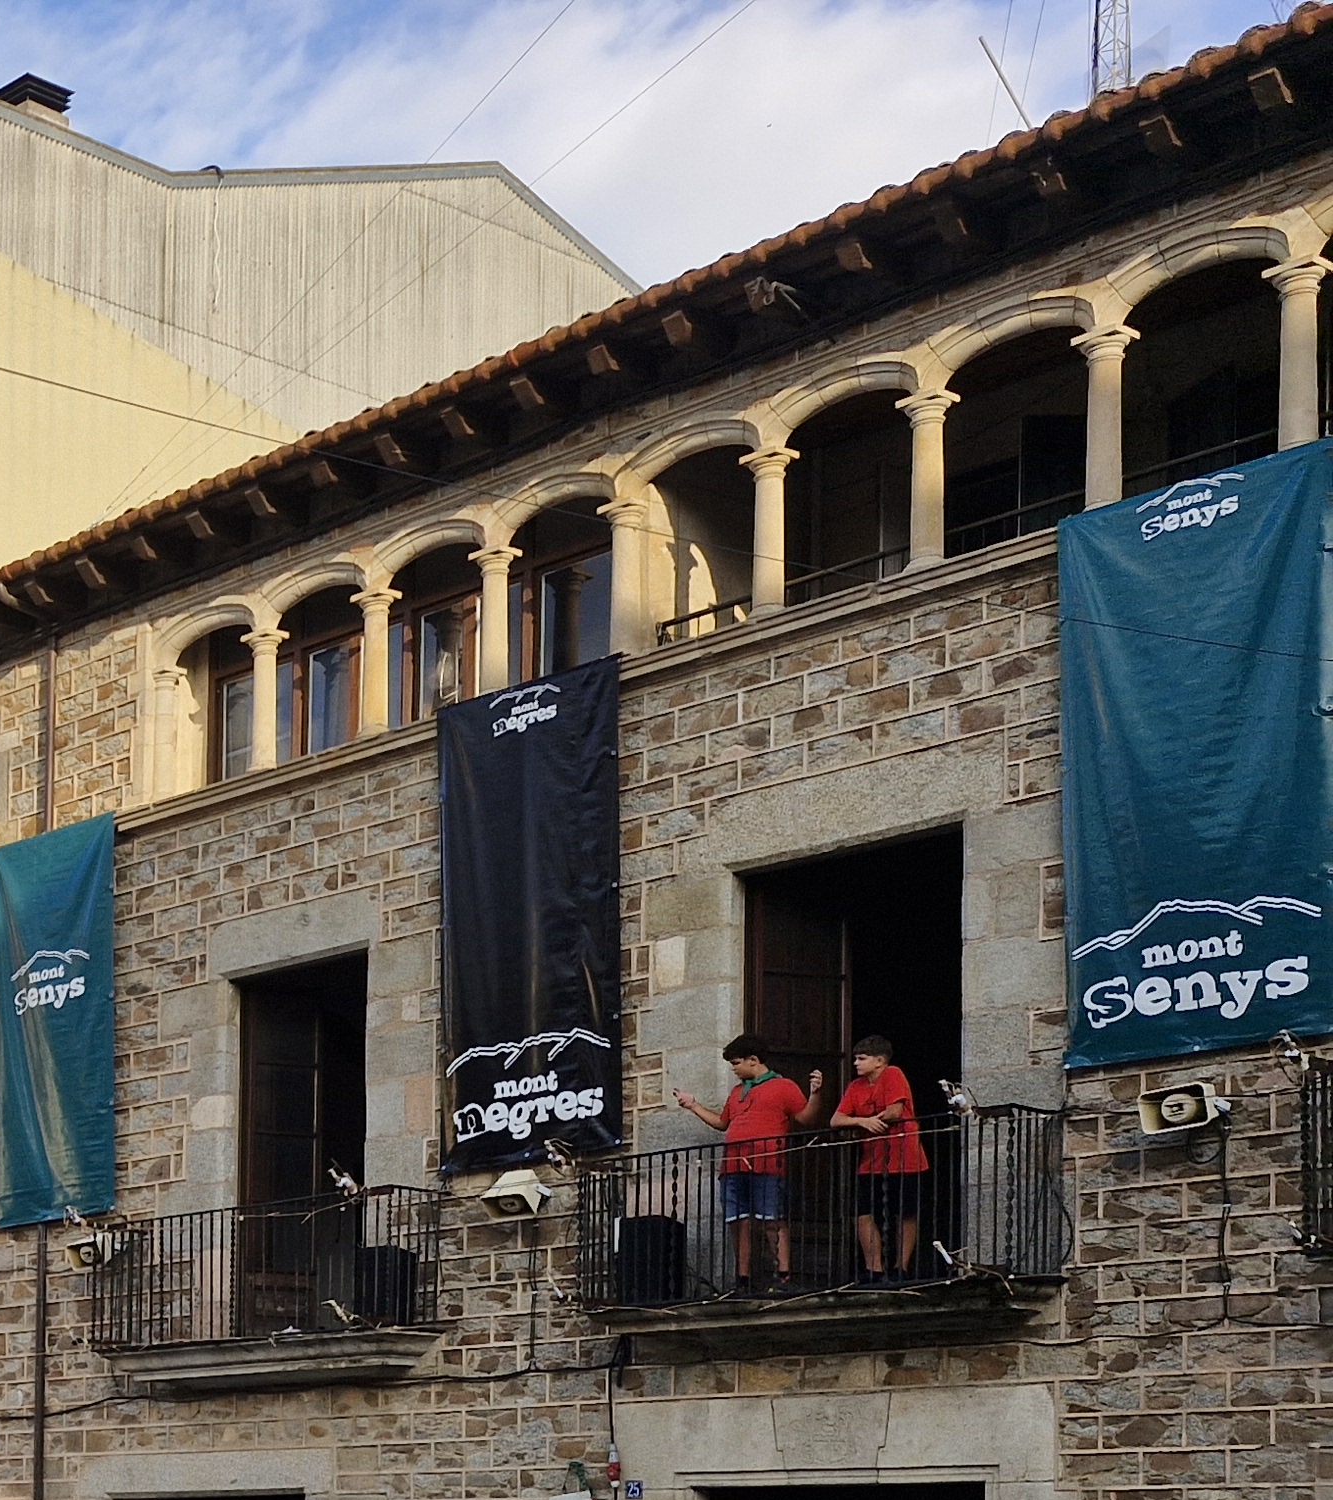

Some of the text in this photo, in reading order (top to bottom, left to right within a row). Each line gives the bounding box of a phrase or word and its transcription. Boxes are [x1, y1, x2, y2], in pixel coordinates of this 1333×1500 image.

[1166, 488, 1212, 511] mont
[492, 703, 558, 738] negres
[510, 700, 539, 715] mont
[1142, 930, 1243, 968] mont
[28, 964, 65, 984] mont
[494, 1070, 558, 1099] mont
[453, 1087, 604, 1143] negres
[627, 1482, 640, 1498] 25
